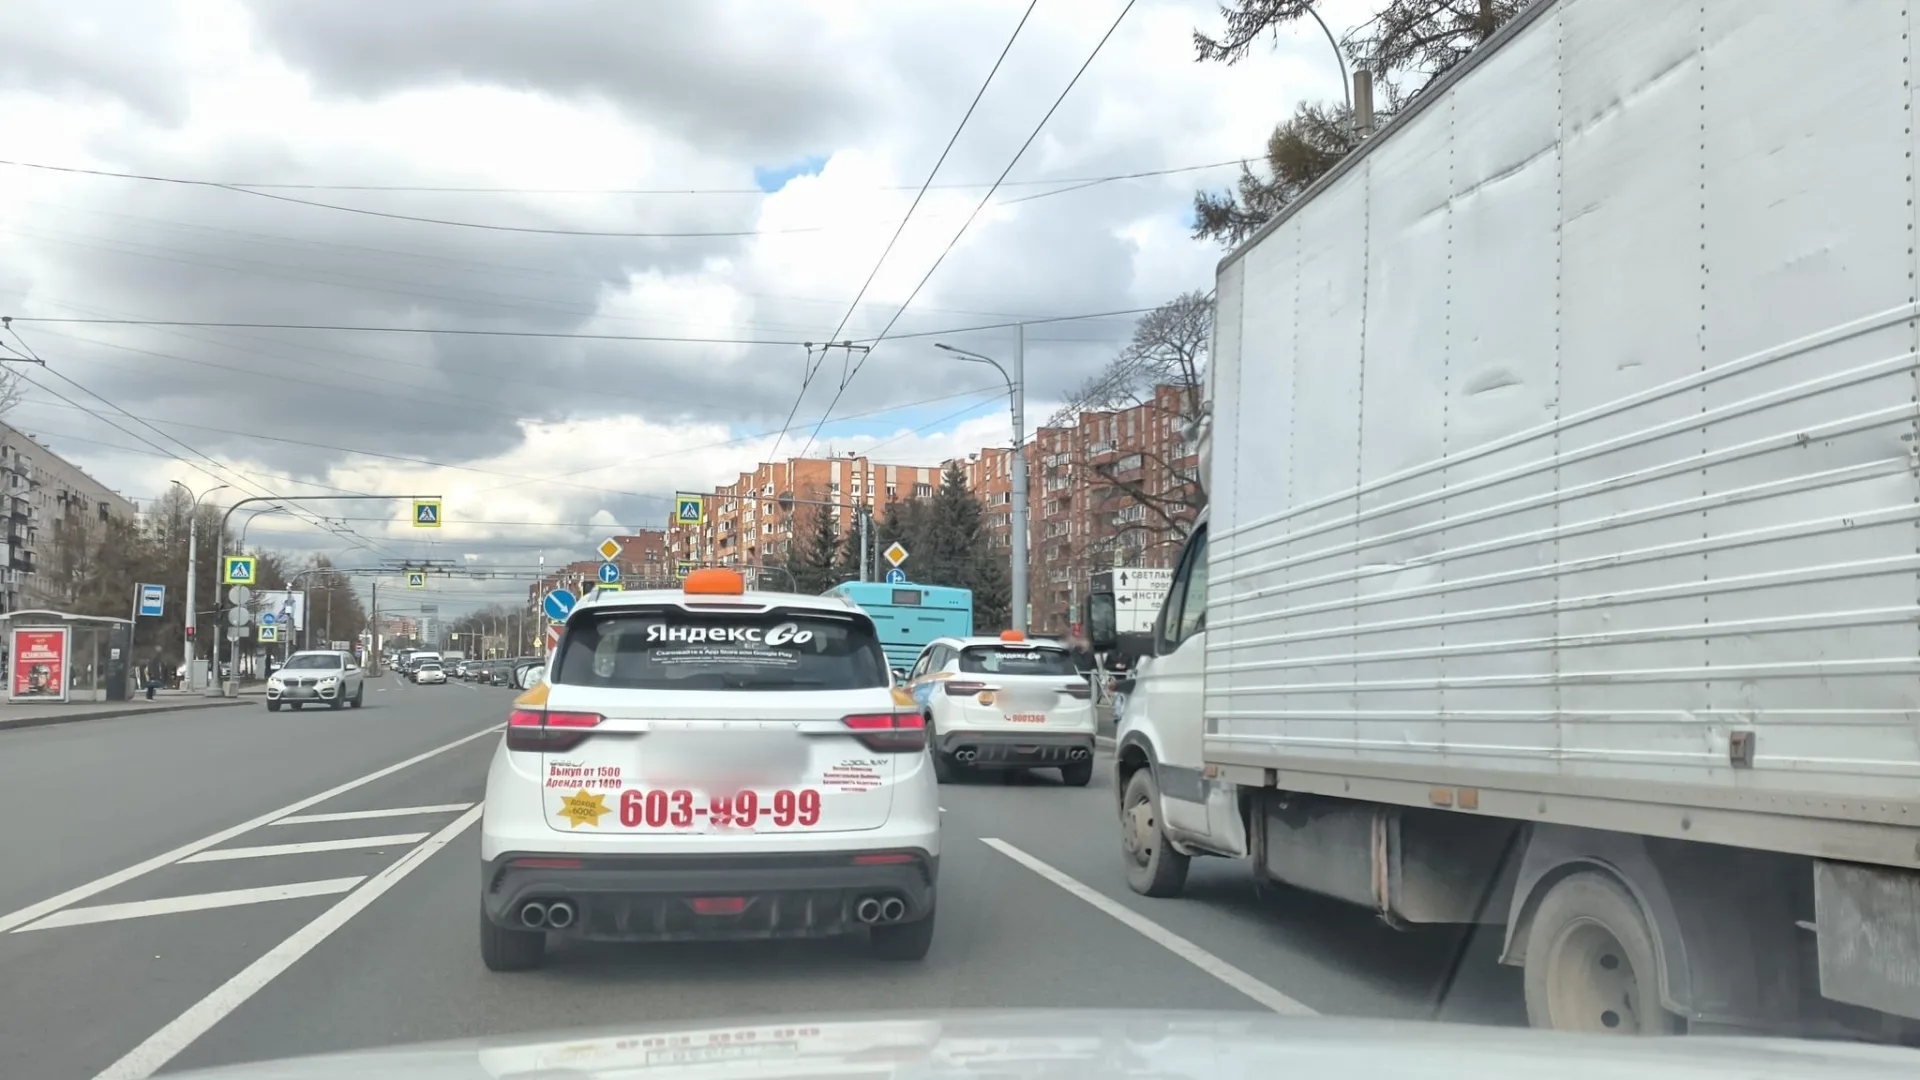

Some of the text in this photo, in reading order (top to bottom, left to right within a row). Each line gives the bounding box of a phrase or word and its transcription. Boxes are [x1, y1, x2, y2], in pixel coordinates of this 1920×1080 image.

[1131, 571, 1173, 579] СВЕТЛАН
[646, 622, 813, 646] Яндекс Go
[550, 766, 621, 778] Выкуп от 1500
[546, 778, 583, 788] Аренда
[585, 779, 596, 788] от
[620, 789, 821, 827] 603-99-99
